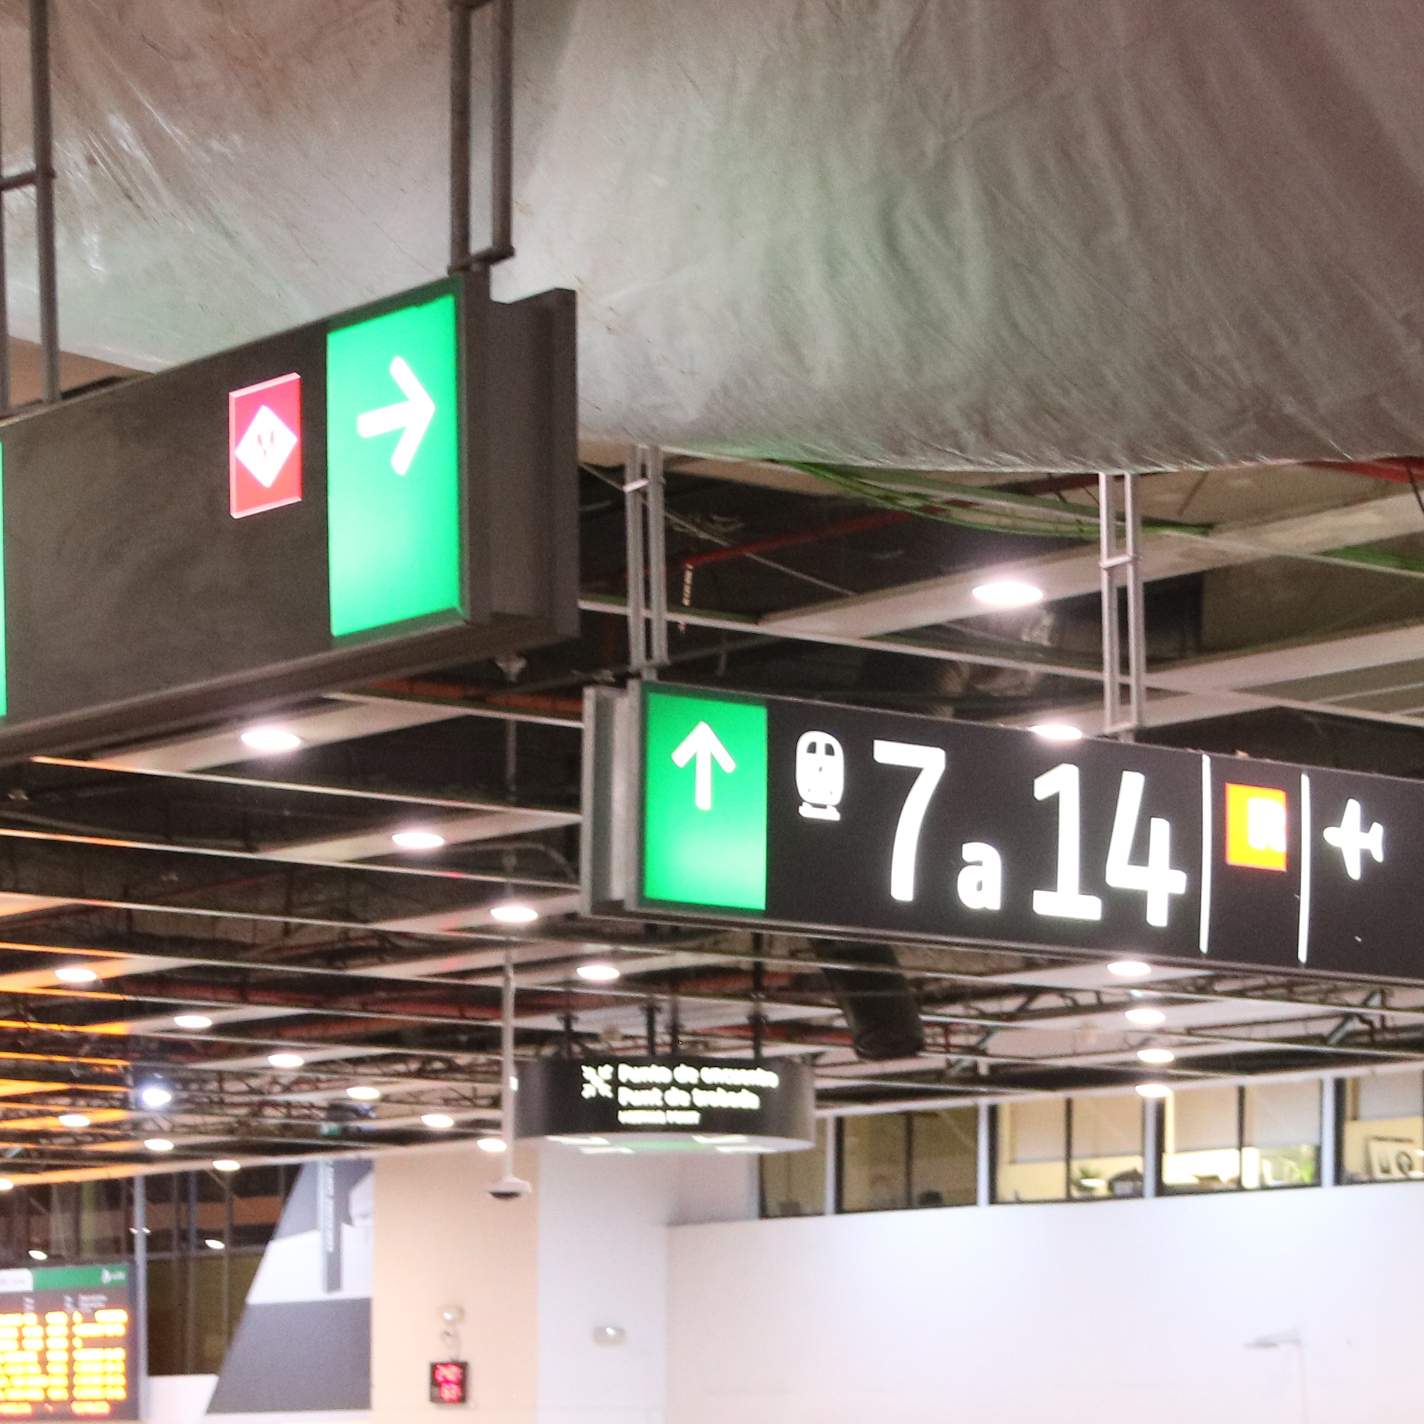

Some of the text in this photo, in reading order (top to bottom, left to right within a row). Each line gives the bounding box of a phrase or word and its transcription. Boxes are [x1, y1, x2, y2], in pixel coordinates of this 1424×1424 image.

[873, 739, 1188, 928] 7 a 14
